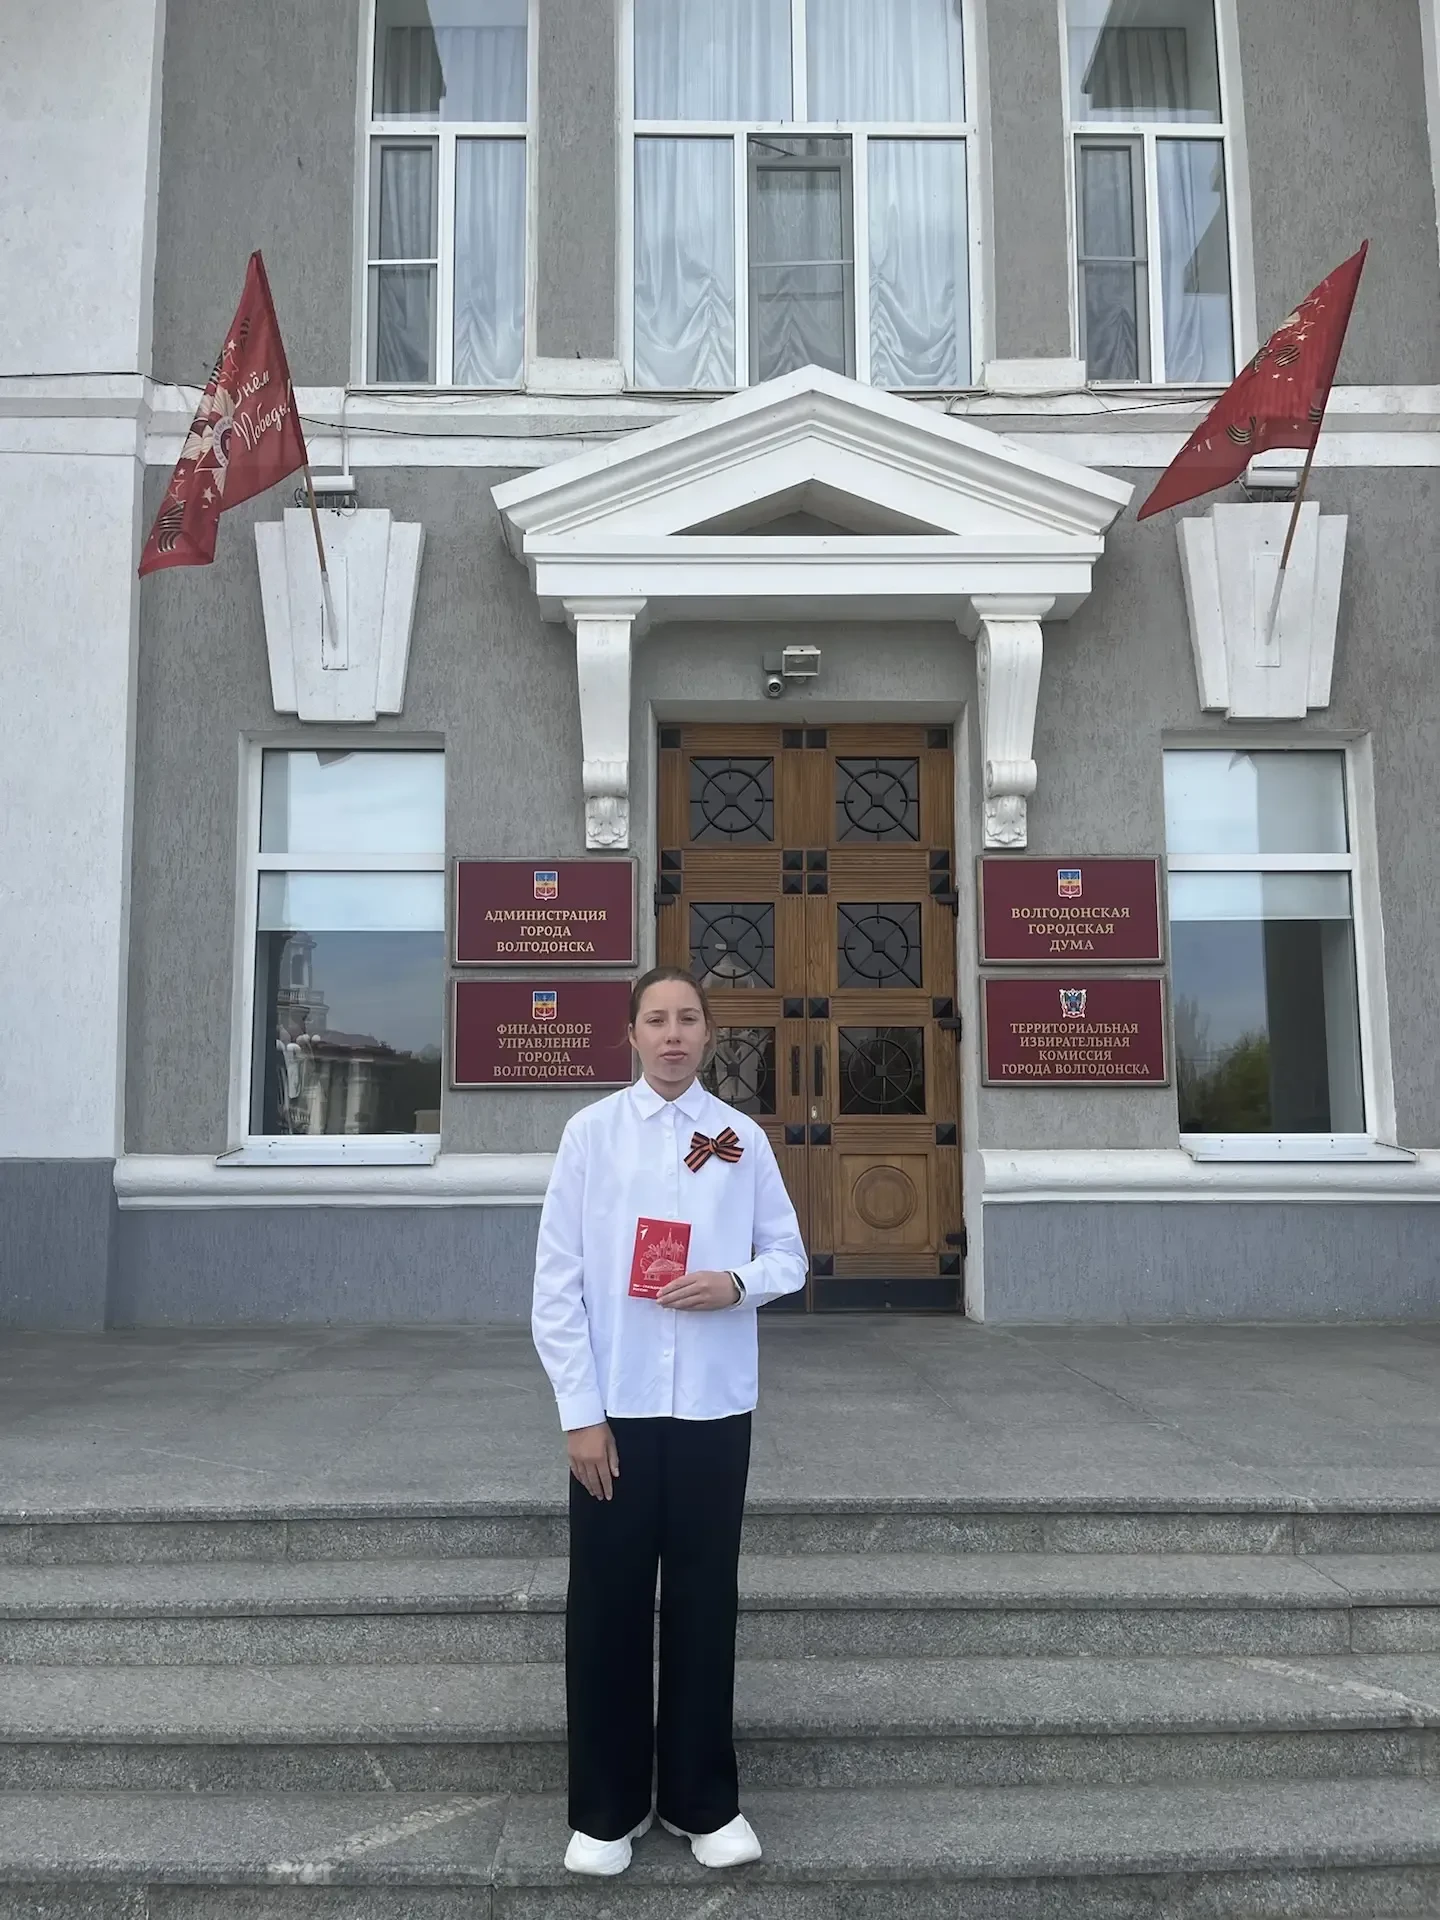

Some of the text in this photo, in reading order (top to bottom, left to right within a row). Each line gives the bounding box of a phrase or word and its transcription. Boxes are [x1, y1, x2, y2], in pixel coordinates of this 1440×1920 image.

[484, 910, 607, 922] АДМИНИСТРАЦИЯ
[1011, 907, 1131, 920] ВОЛГОДОНСКАЯ
[520, 925, 572, 938] ГОРОДА
[1028, 923, 1115, 936] ГОРОДСКАЯ
[496, 941, 595, 953] ВОЛГОДОНСКА
[1049, 939, 1095, 952] ДУМА
[496, 1023, 593, 1035] ФИНАНСОВОЕ
[1009, 1023, 1139, 1034] ТЕРРИТОРИАЛЬНАЯ
[498, 1037, 590, 1049] УПРАВЛЕНИЕ
[1020, 1036, 1130, 1047] ИЗБИРАТЕЛЬНАЯ
[517, 1051, 571, 1064] ГОРОДА
[1038, 1050, 1112, 1061] КОМИССИЯ
[493, 1065, 595, 1078] ВОЛГОДОНСКА
[1001, 1063, 1150, 1076] ГОРОДА ВОЛГОДОНСКА
